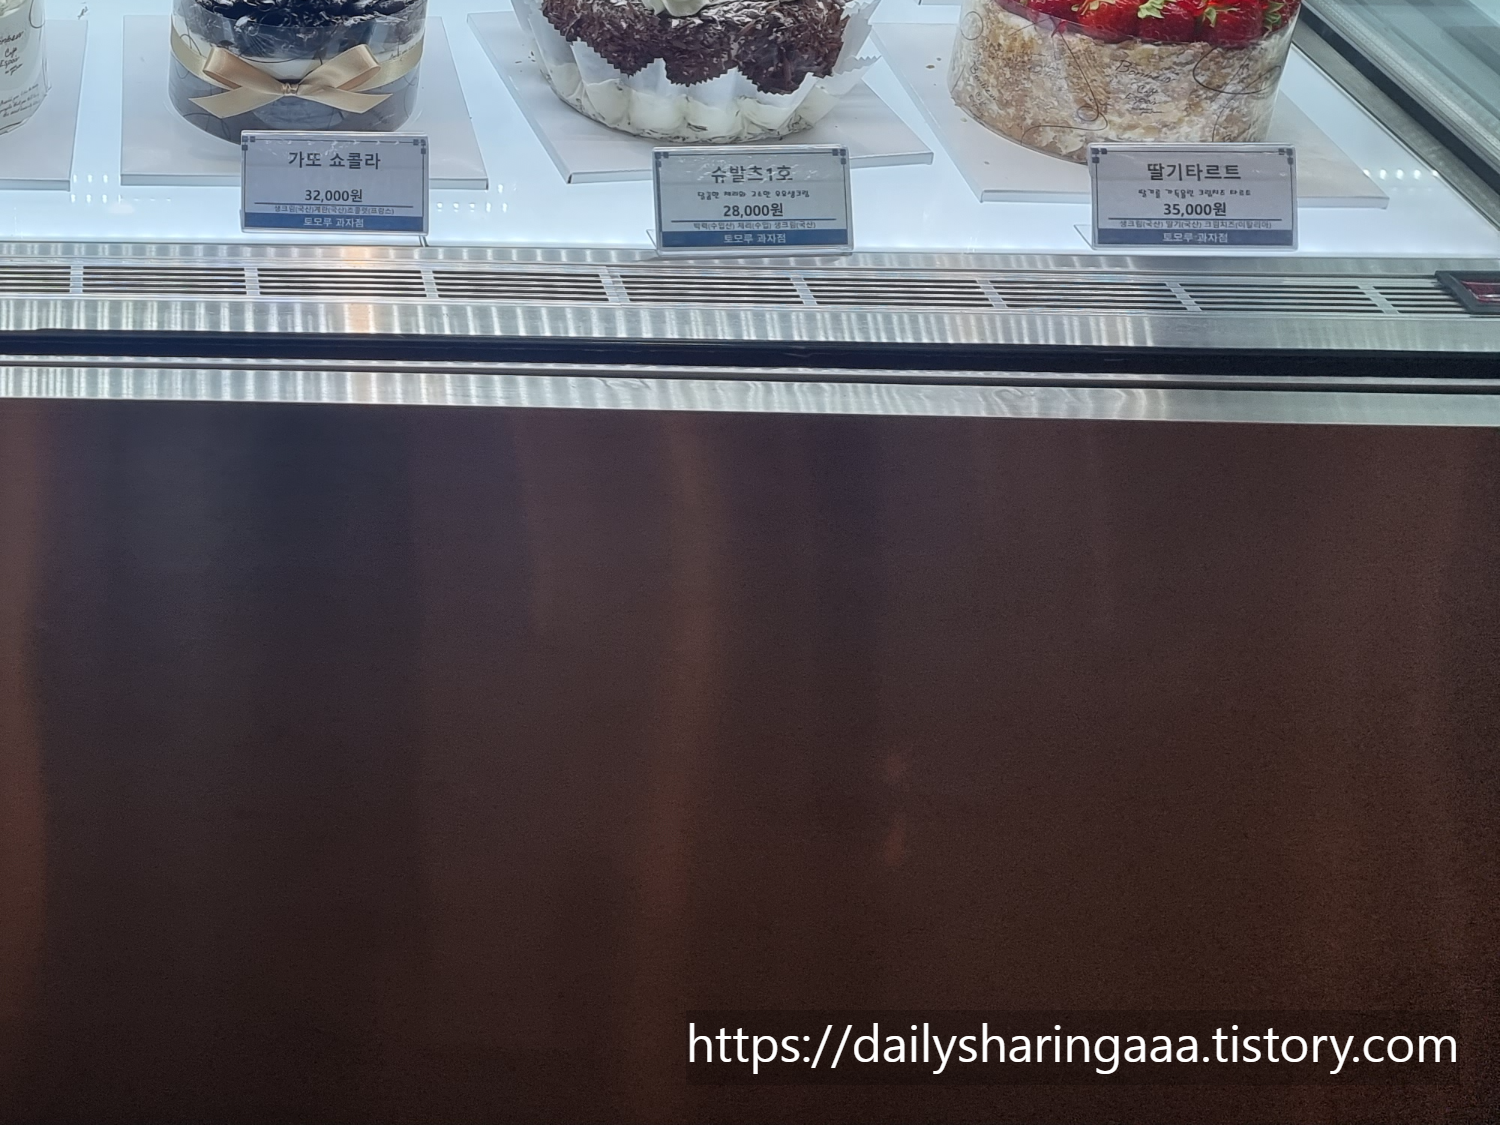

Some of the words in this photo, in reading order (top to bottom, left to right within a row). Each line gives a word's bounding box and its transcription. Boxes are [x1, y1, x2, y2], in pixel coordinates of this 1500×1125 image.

[288, 151, 322, 168] 가또
[329, 152, 381, 170] 쇼콜라
[711, 165, 793, 184] 슈발츠1호
[1147, 163, 1241, 182] 딸기타르트
[304, 189, 363, 203] 32,000원
[723, 203, 784, 218] 28,000원
[1163, 202, 1227, 217] 35,000원
[303, 217, 332, 227] 토모루
[336, 218, 364, 228] 과자점
[723, 233, 753, 244] 토모루
[756, 233, 786, 243] 과자점
[1162, 233, 1193, 242] 토모루
[1197, 233, 1228, 243] 과자점
